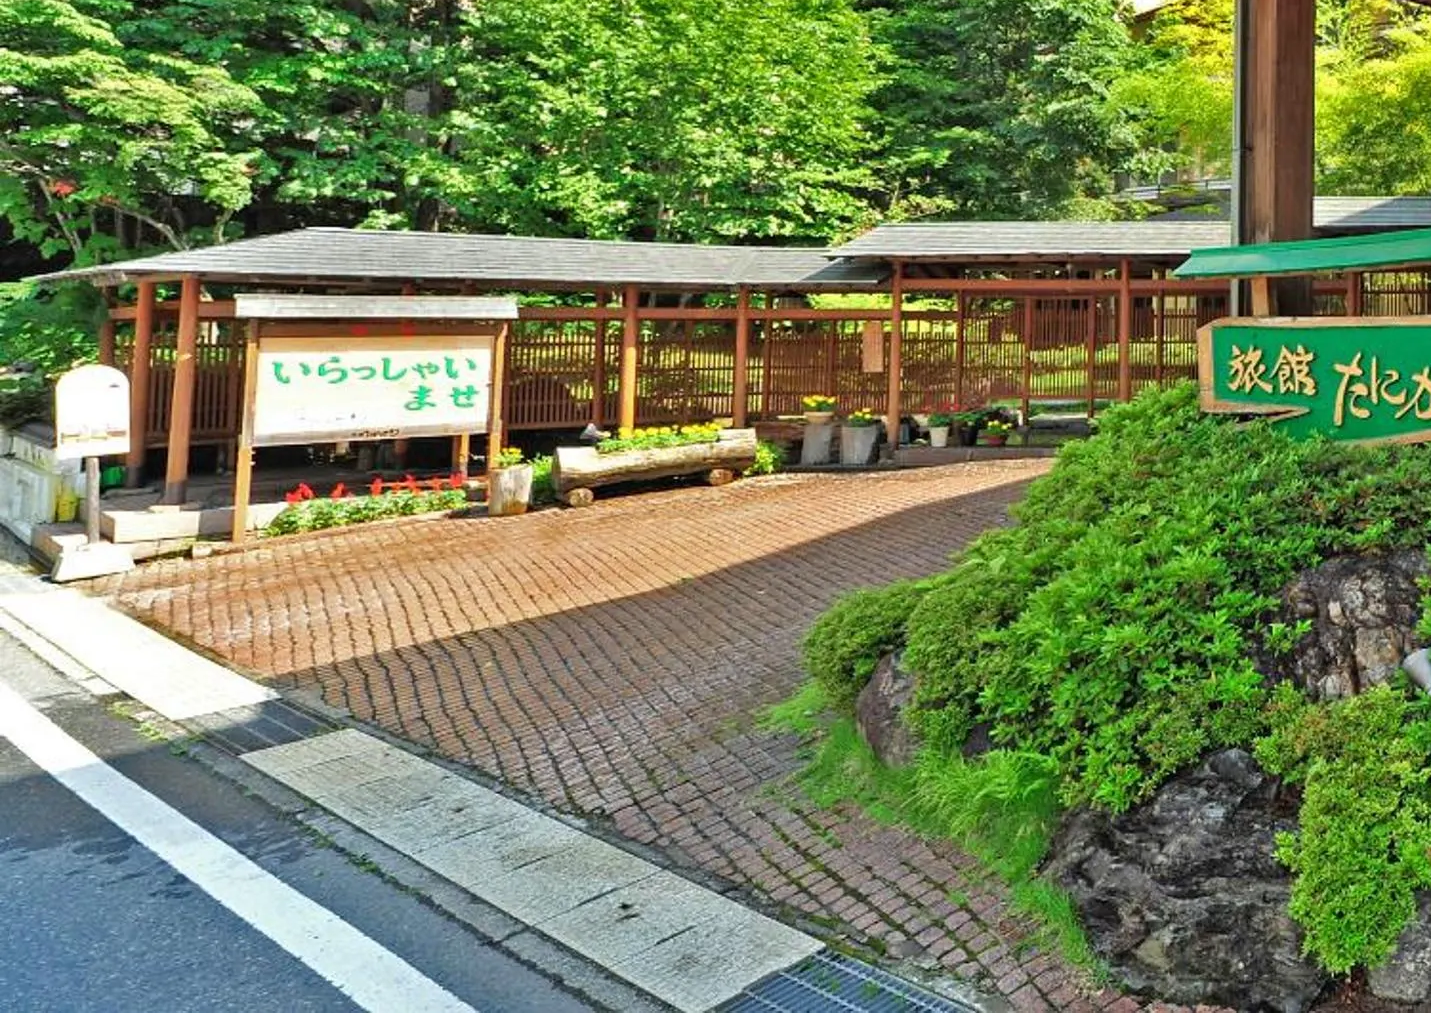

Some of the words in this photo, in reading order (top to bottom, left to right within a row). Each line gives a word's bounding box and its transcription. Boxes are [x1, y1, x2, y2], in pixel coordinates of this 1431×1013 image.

[272, 356, 478, 384] いらっしゃい
[1228, 344, 1318, 395] 旅館
[404, 385, 480, 411] ませ
